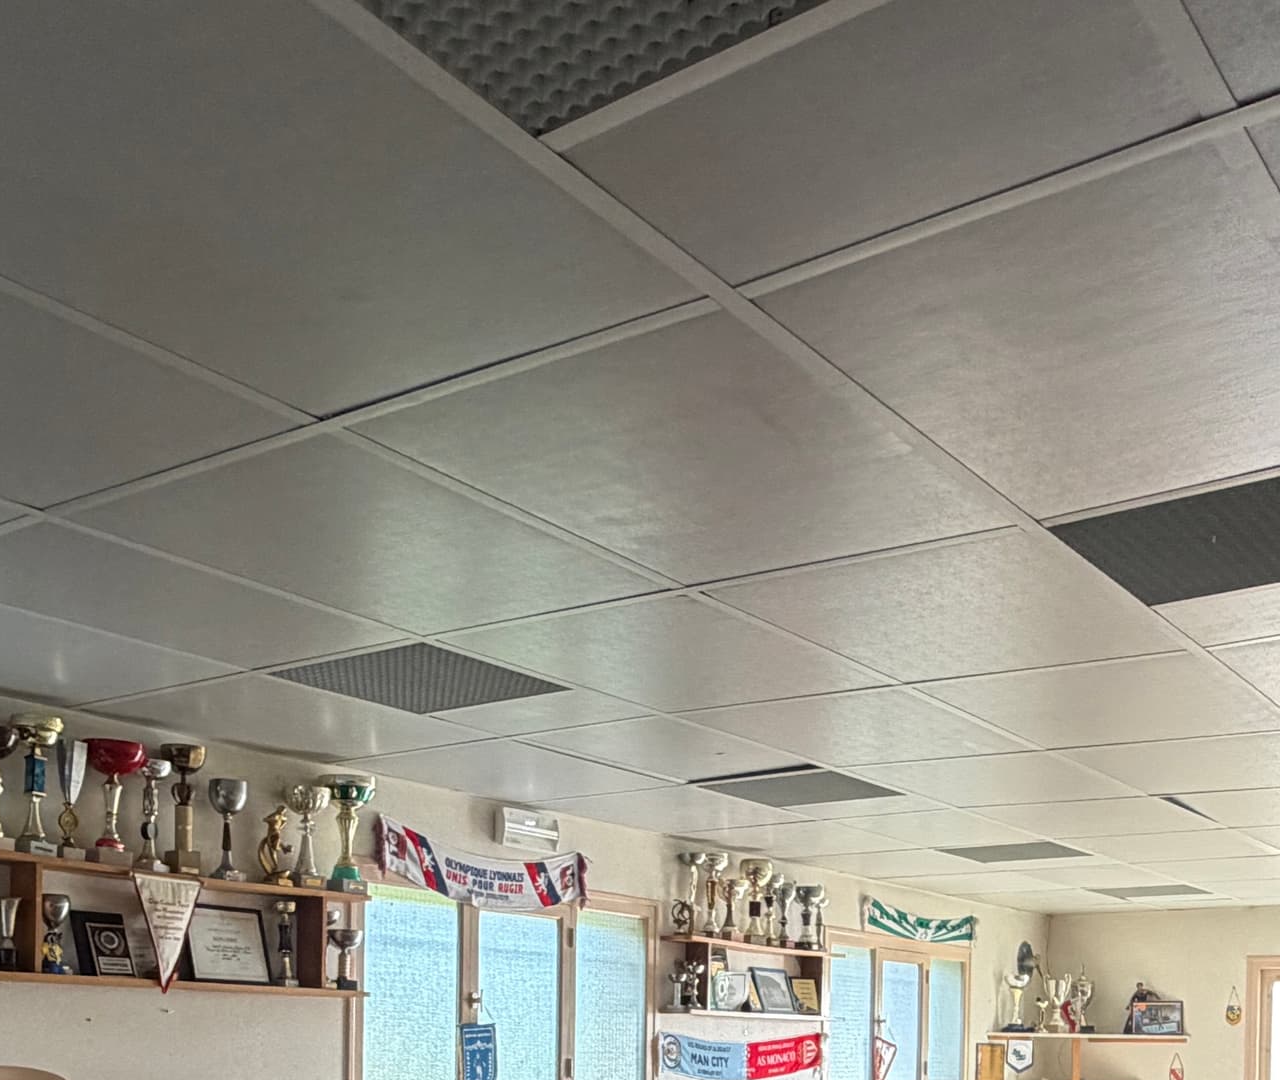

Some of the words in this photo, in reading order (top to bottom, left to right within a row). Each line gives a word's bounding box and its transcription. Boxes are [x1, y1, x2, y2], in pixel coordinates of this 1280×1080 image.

[444, 856, 489, 879] OLYMPIQUE
[489, 869, 525, 883] LYONNAIS
[445, 869, 469, 886] UNIS
[472, 878, 495, 891] POUR
[498, 882, 524, 895] RUGIR
[690, 1052, 709, 1066] MAN
[711, 1056, 729, 1069] CITY
[756, 1055, 767, 1067] AS
[767, 1050, 796, 1065] MONACO
